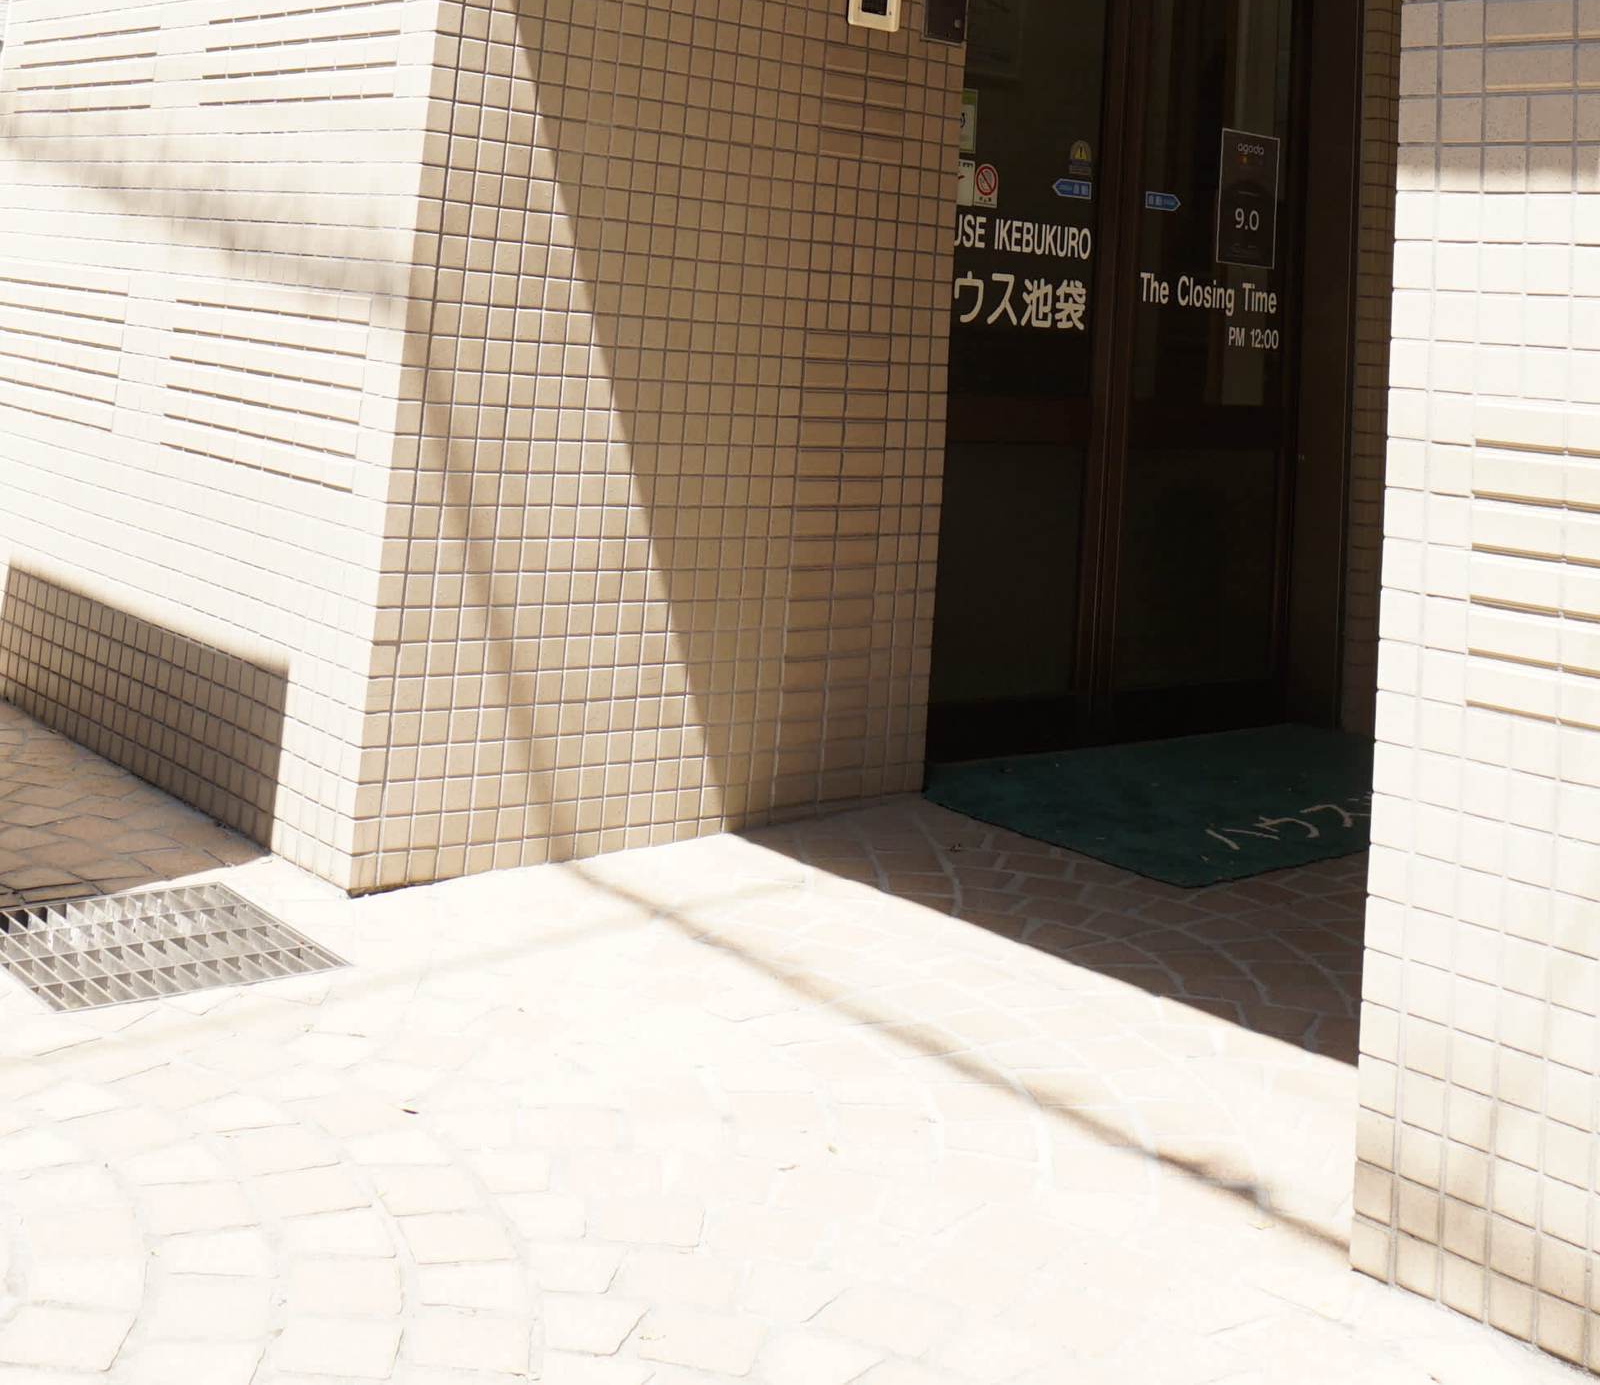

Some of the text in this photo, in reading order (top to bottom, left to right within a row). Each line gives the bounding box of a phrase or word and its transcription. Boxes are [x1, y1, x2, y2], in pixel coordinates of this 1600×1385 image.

[1237, 143, 1264, 156] agoda
[1235, 208, 1260, 231] 9.0
[994, 218, 1092, 260] IKEBUKURO
[953, 270, 1087, 331] ウス池袋
[1140, 271, 1277, 317] The Closing Time
[1228, 326, 1280, 350] PM 12:00
